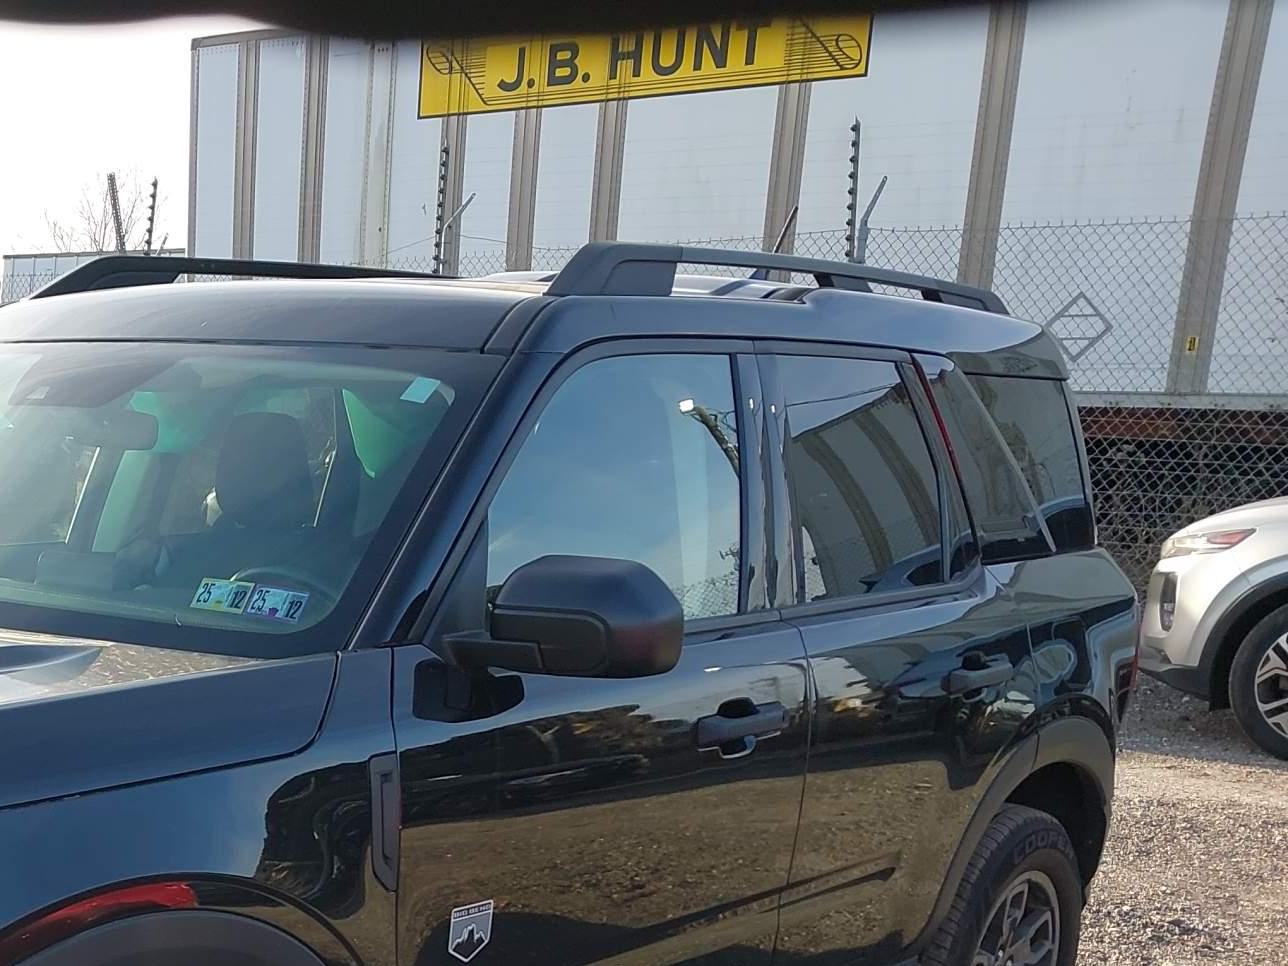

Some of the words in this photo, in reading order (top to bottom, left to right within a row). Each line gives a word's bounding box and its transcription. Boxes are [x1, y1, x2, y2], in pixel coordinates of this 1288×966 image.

[608, 20, 773, 80] HUNT
[196, 582, 216, 603] 25
[229, 589, 248, 609] 12
[250, 589, 271, 612] 25
[285, 600, 304, 620] 12
